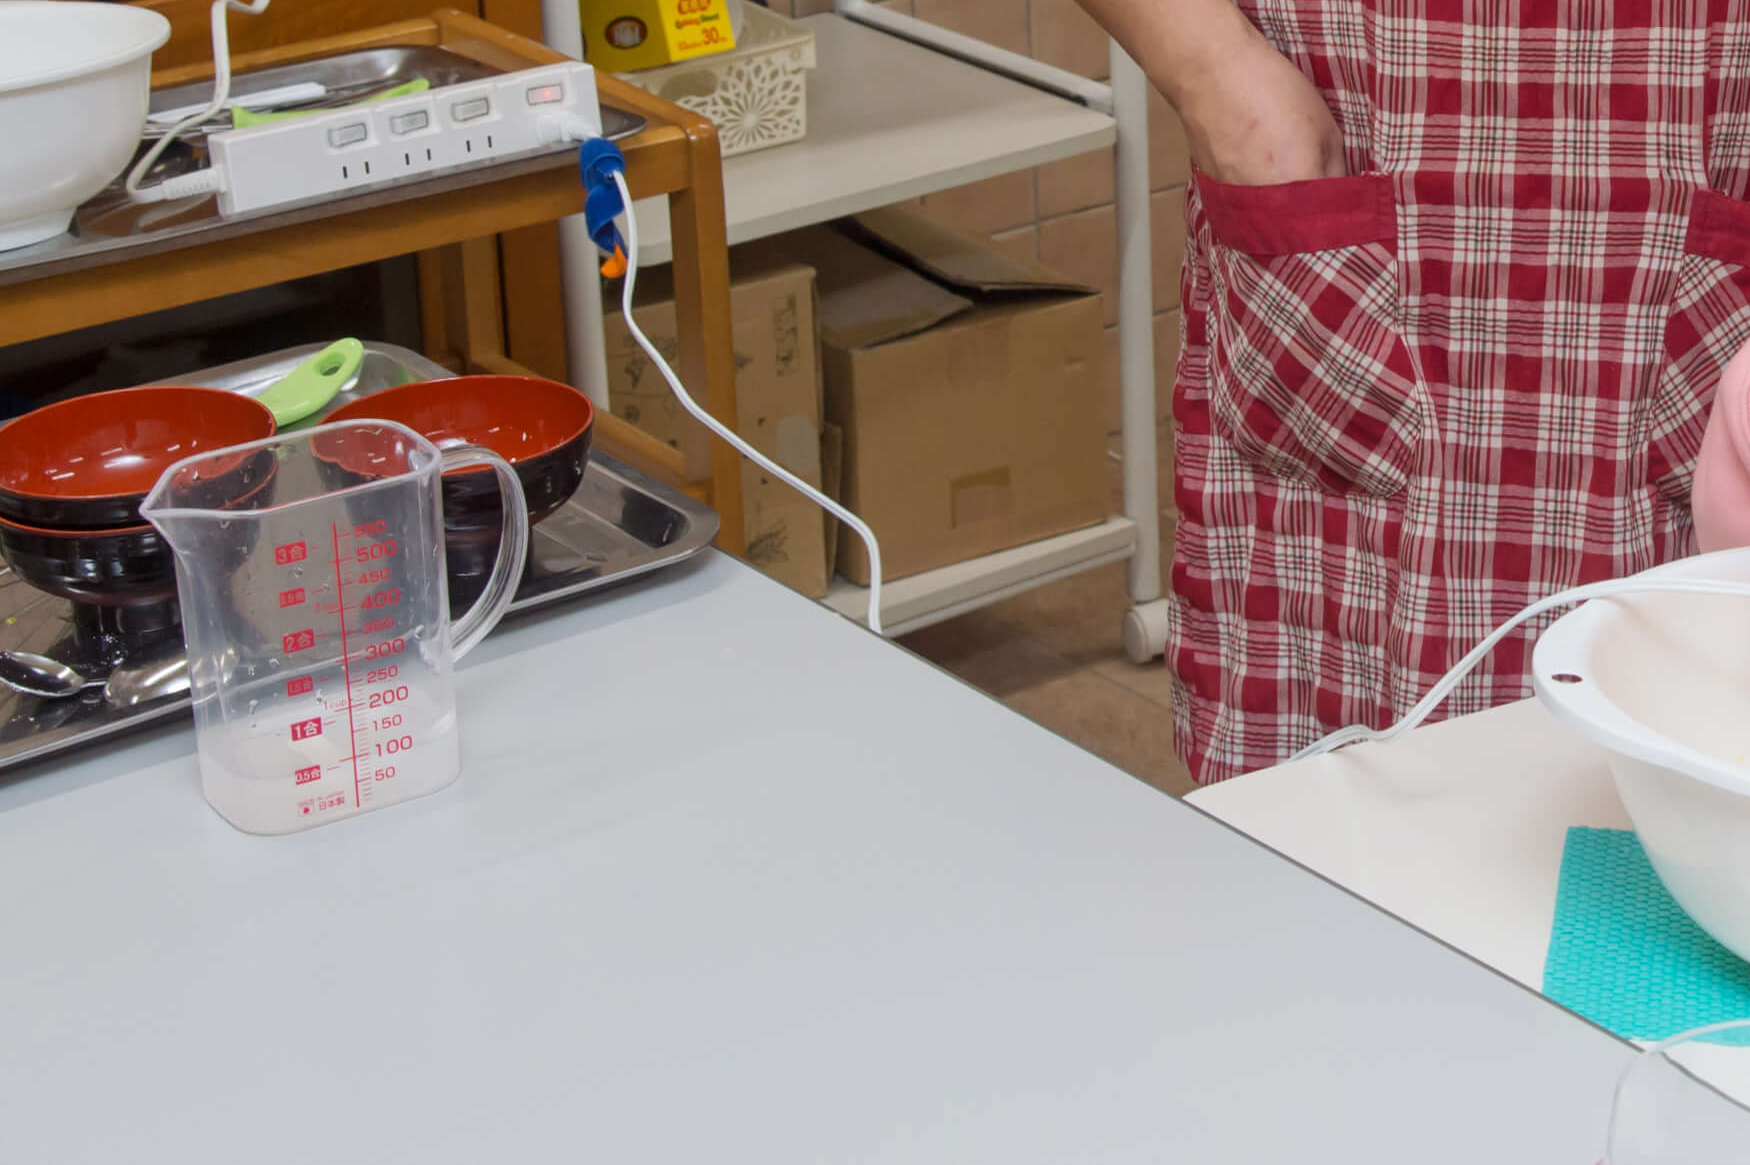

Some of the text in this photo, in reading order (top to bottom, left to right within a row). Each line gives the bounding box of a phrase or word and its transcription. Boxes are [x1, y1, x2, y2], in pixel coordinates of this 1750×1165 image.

[276, 542, 307, 565] 3合
[356, 539, 398, 563] 500
[358, 567, 391, 585] 450
[360, 587, 402, 610] 400
[361, 616, 395, 635] 350
[283, 629, 314, 654] 2合
[364, 636, 405, 662] 300
[367, 664, 399, 684] 250
[368, 685, 409, 709] 200
[291, 717, 322, 741] 1合
[372, 714, 402, 732] 150
[375, 734, 413, 758] 100
[375, 765, 396, 782] 50
